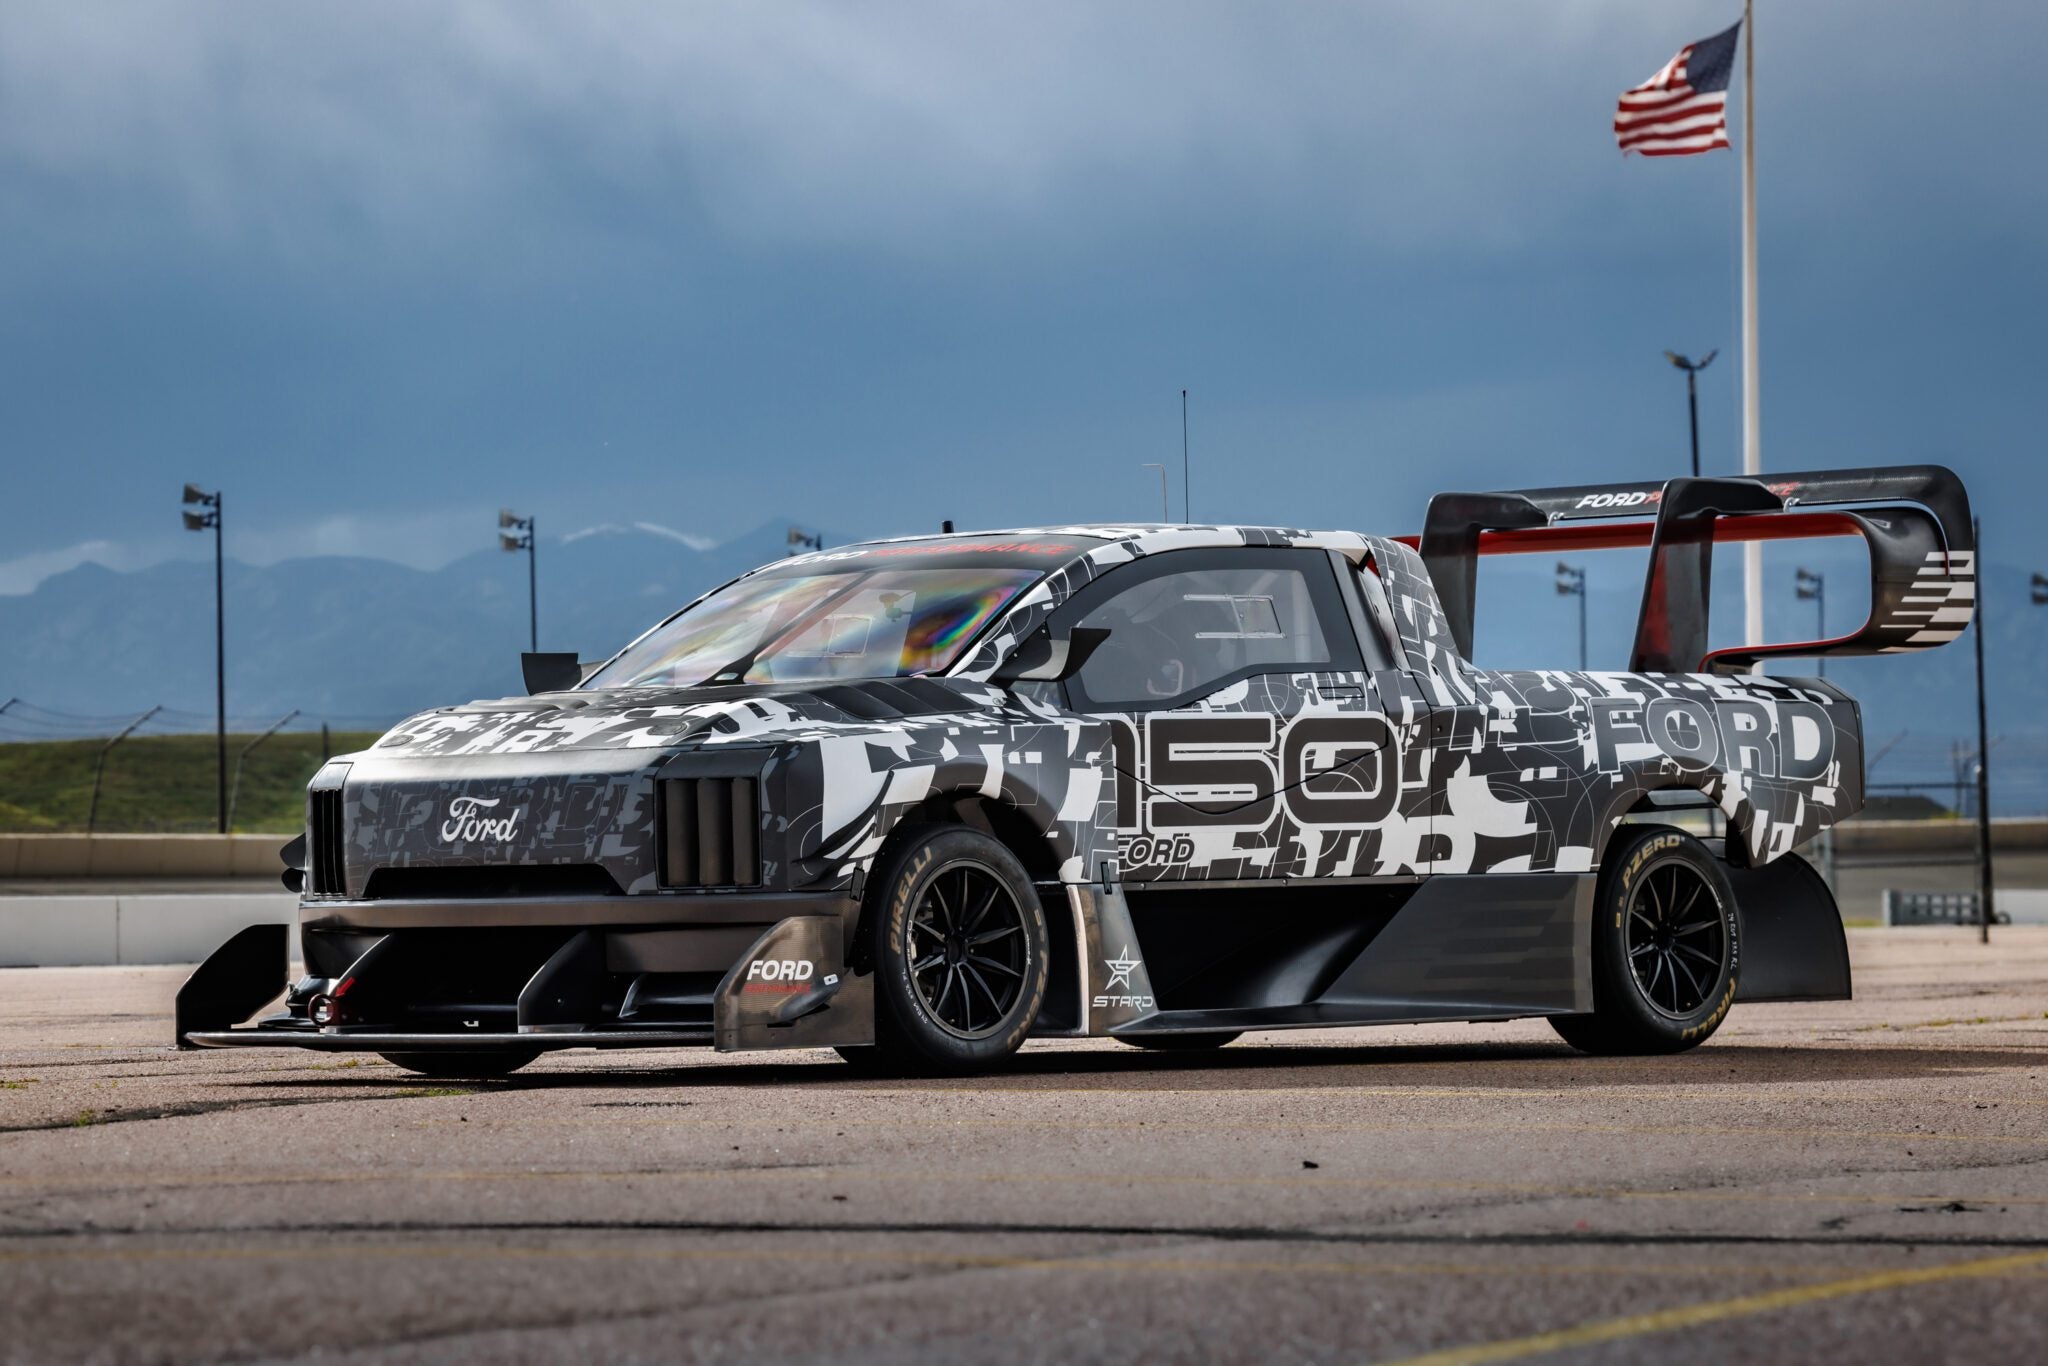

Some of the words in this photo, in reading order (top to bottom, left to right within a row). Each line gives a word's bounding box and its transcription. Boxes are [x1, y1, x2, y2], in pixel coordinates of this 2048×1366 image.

[1576, 492, 1648, 509] FORD
[1588, 697, 1836, 782] FORD
[1111, 711, 1401, 834] 150
[441, 796, 520, 842] Ford
[889, 846, 933, 956] PIRELLI
[746, 960, 814, 981] FORD
[1092, 995, 1154, 1013] STARD
